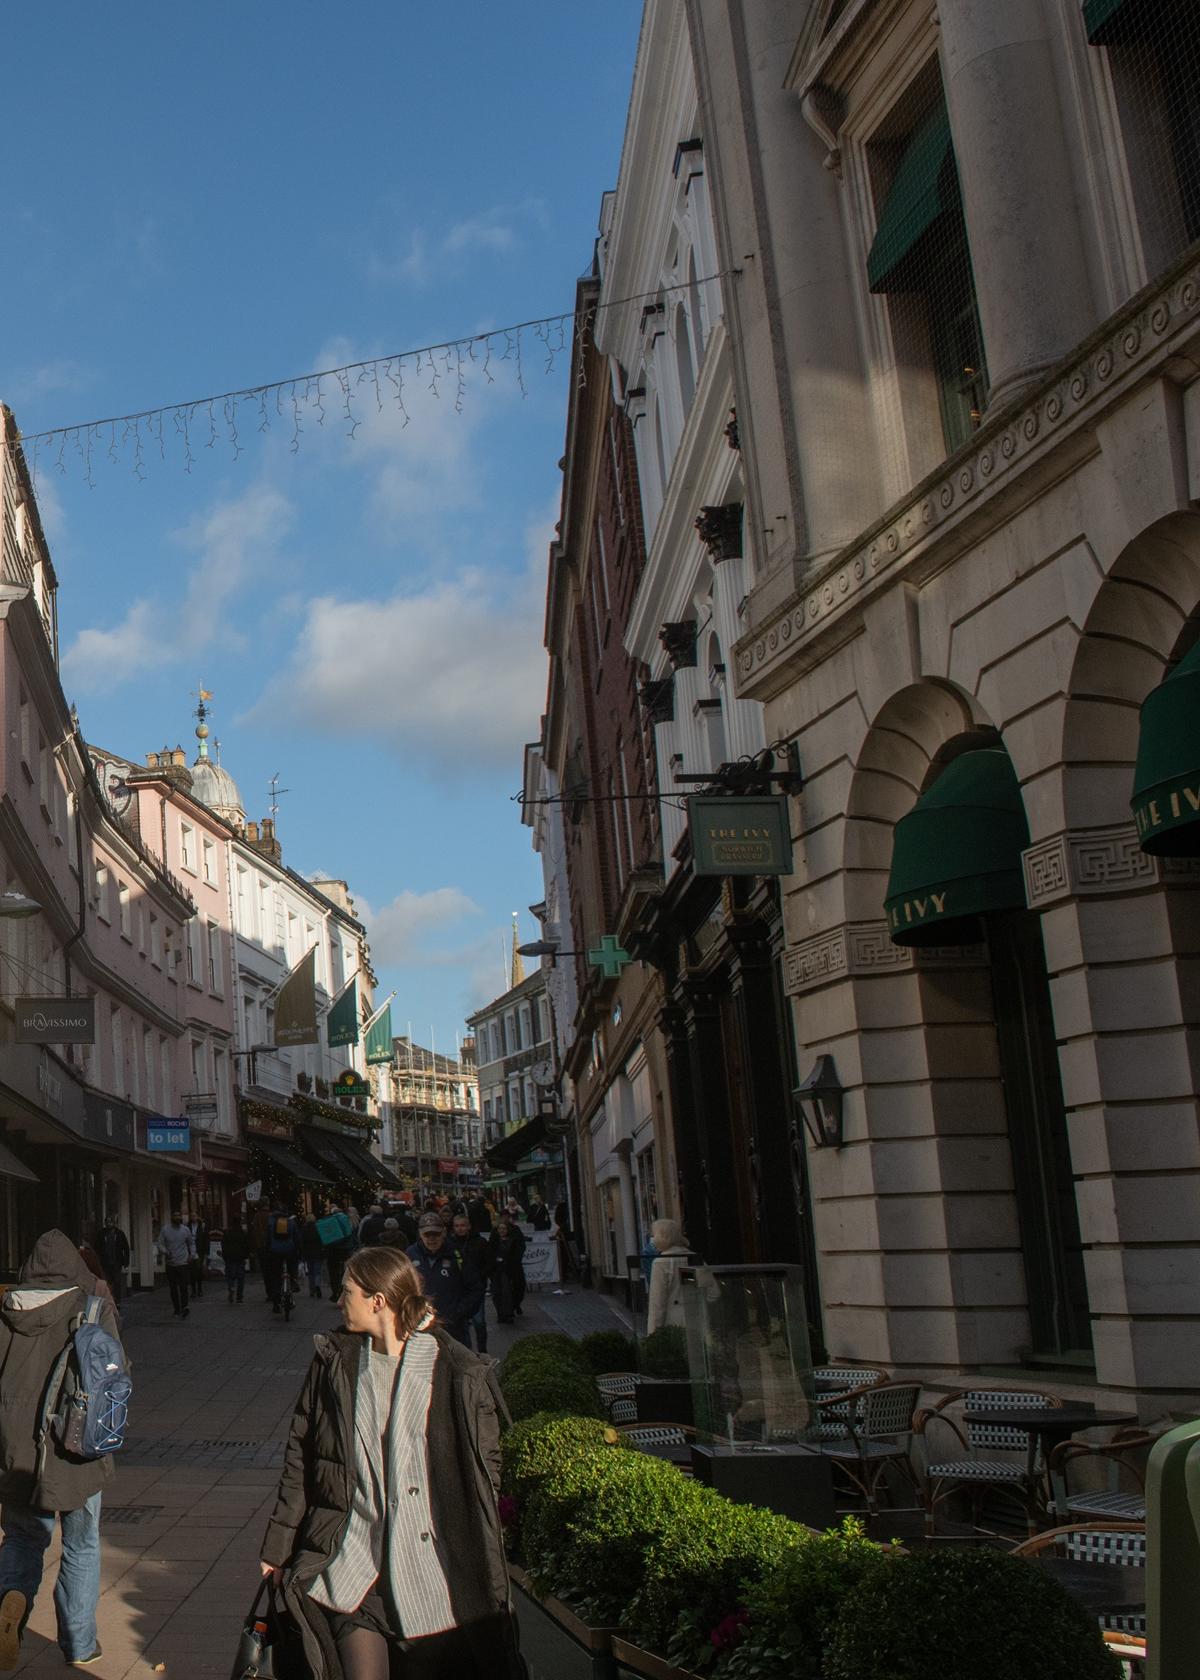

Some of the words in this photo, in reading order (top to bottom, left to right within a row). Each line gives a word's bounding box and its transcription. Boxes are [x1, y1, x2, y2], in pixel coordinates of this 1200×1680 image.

[709, 829, 737, 839] THE
[743, 829, 769, 839] IVY
[904, 891, 947, 923] IVY
[23, 1013, 87, 1030] BRAVISSIMO
[335, 1086, 366, 1095] ROLEX
[150, 1133, 163, 1144] to
[167, 1132, 185, 1144] let
